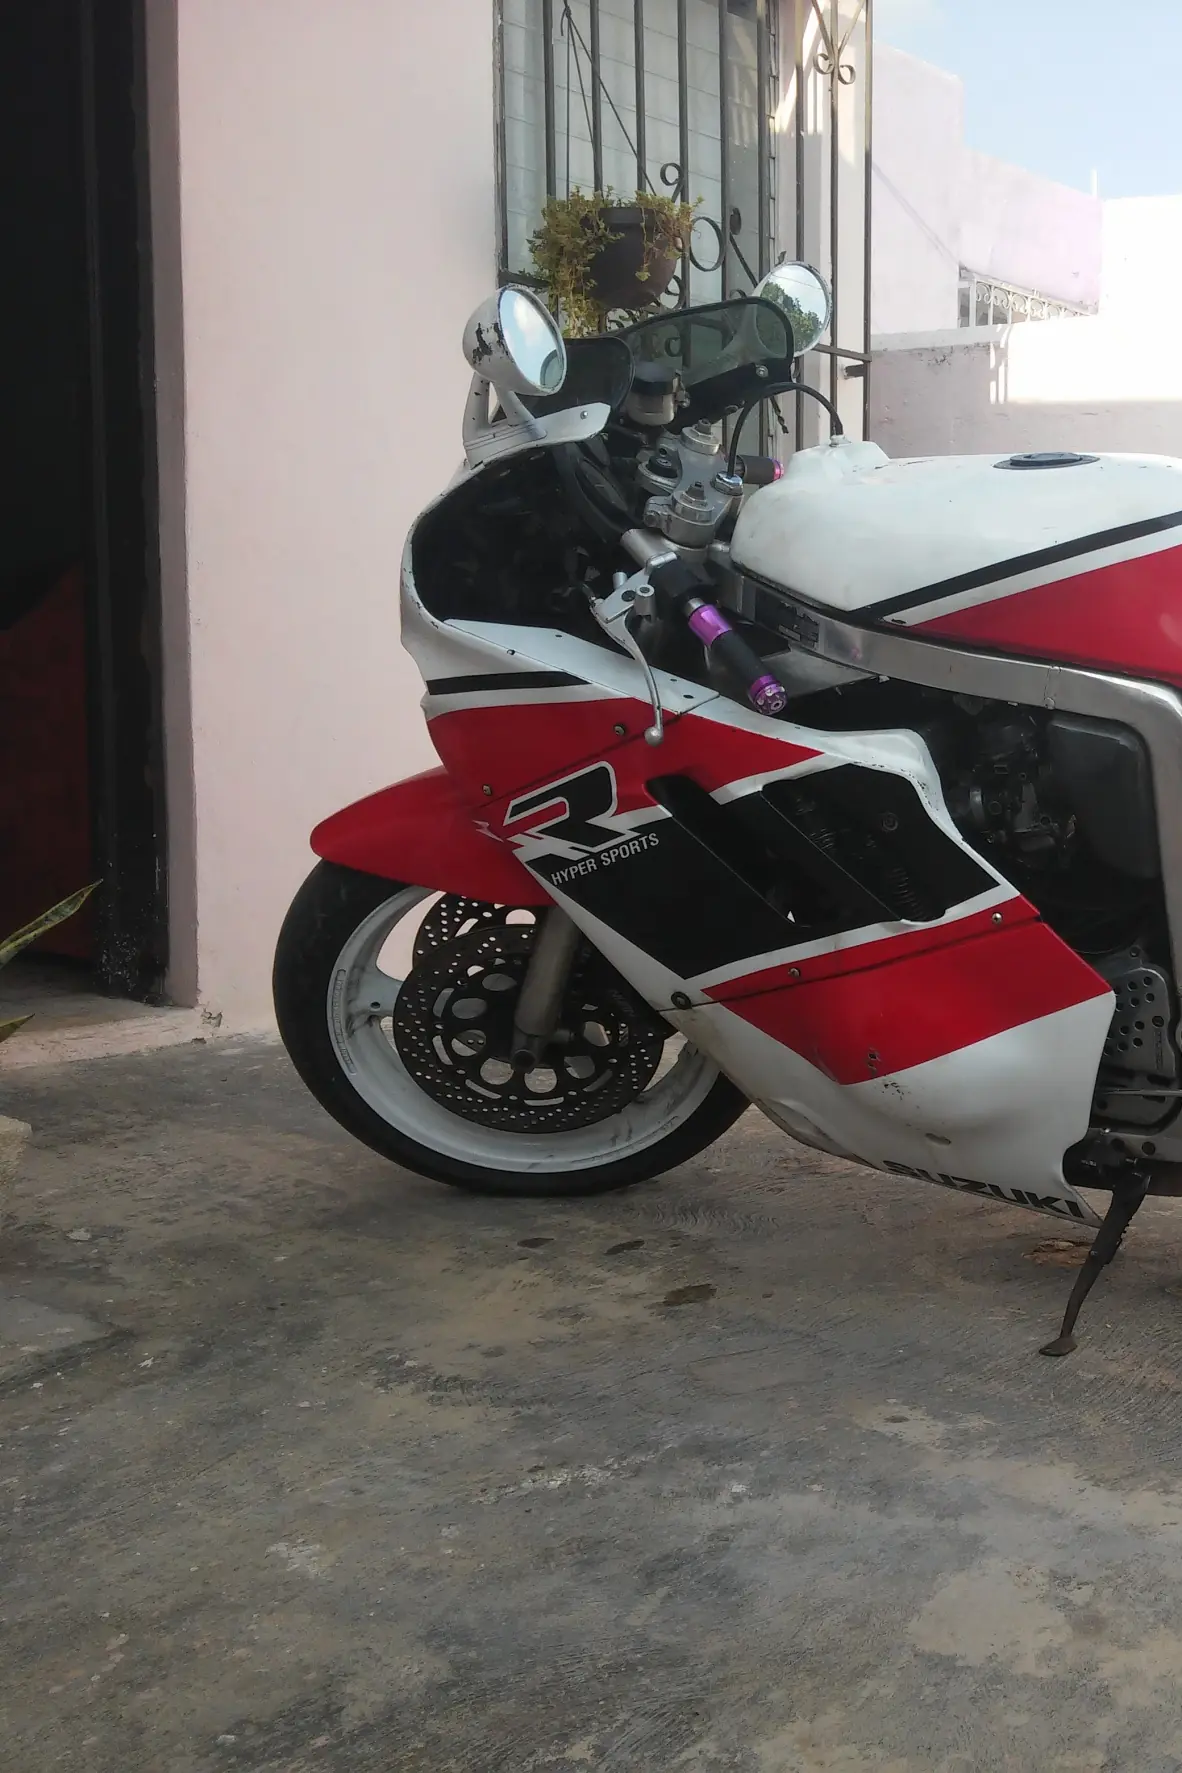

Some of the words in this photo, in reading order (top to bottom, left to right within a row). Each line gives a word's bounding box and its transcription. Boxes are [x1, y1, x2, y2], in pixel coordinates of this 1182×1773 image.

[550, 858, 598, 886] HYPER
[600, 832, 660, 867] SPORTS
[882, 1159, 1085, 1219] SUZUKI
